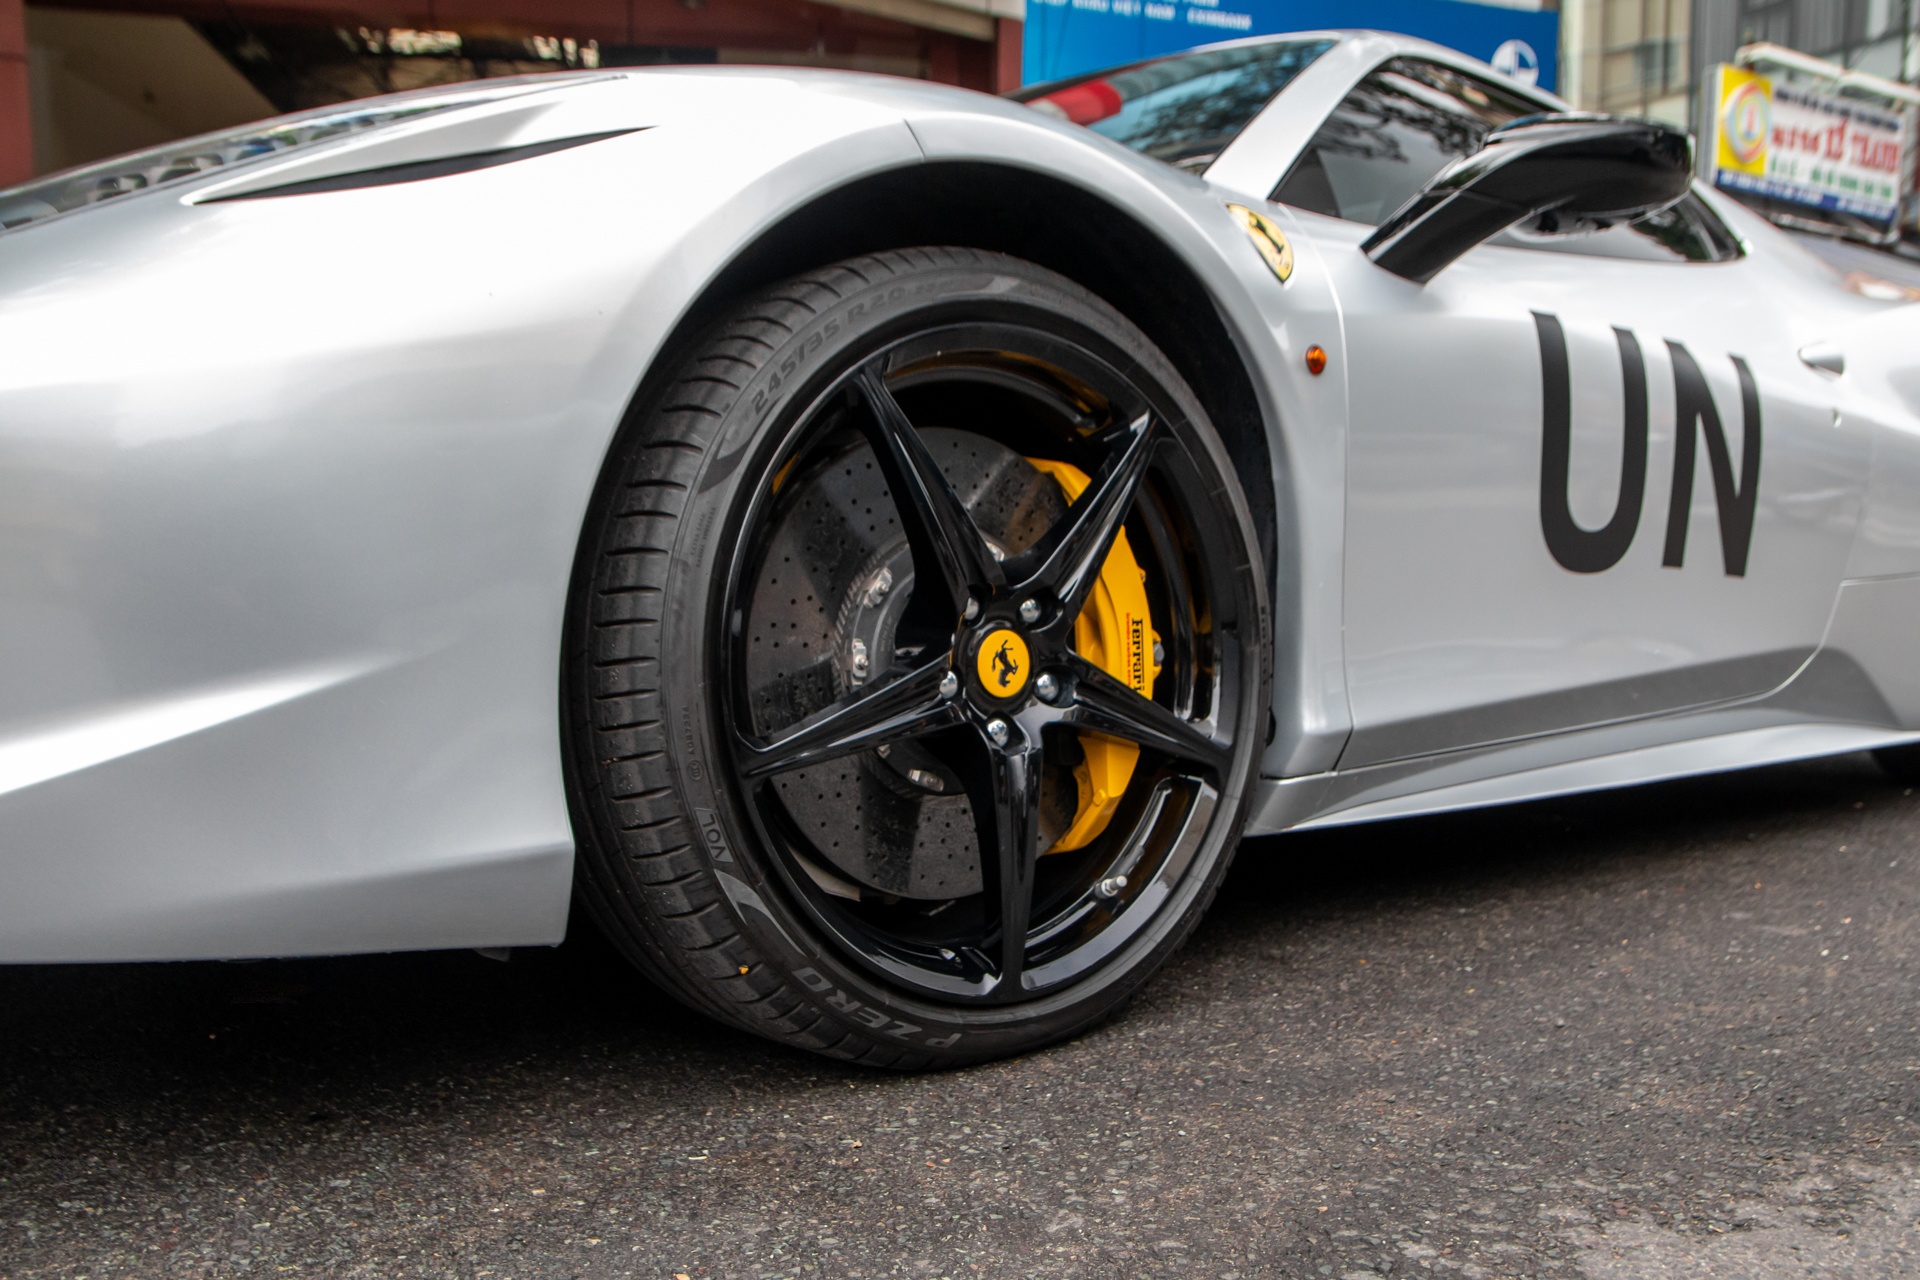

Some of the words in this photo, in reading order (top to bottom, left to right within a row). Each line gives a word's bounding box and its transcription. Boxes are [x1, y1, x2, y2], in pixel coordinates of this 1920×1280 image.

[751, 317, 840, 415] 245/35
[1529, 309, 1761, 578] UN
[1132, 618, 1145, 691] Ferrari
[702, 813, 729, 858] VOL
[792, 967, 922, 1039] ZERO
